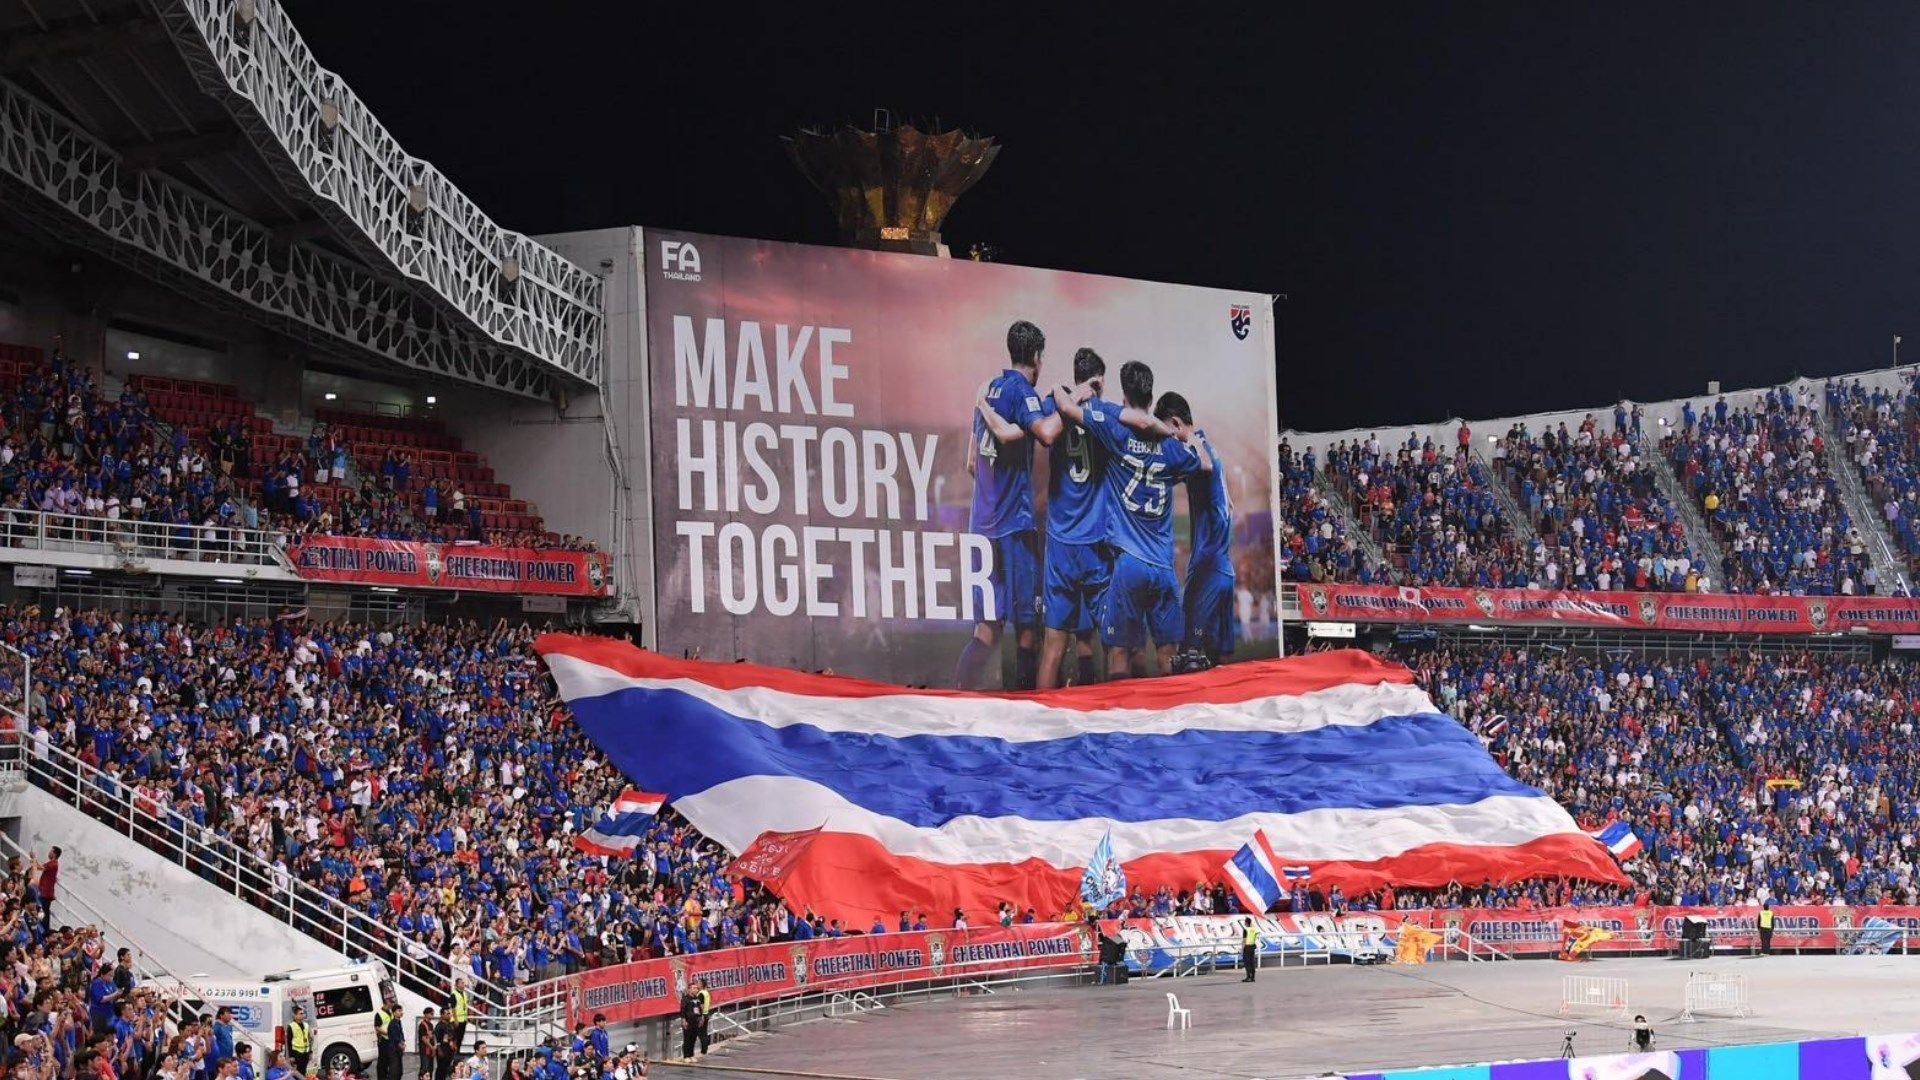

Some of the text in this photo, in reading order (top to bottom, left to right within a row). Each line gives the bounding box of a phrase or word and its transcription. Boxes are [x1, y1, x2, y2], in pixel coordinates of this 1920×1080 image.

[661, 241, 701, 272] FA
[663, 271, 702, 282] THAILAND
[673, 315, 854, 417] MAKE
[676, 418, 939, 521] HISTORY
[1121, 454, 1167, 516] 25
[365, 549, 418, 574] POWER
[446, 556, 577, 583] CHEERTHAI POWER
[675, 520, 997, 621] TOGETHER
[1419, 598, 1466, 610] OWER
[1664, 605, 1799, 623] CHEERTHAI POWER
[1837, 609, 1920, 621] CHEERTHAI
[1470, 920, 1560, 941] CHEERTHAI
[1773, 916, 1820, 936] OWER
[952, 937, 1074, 963] CHEERTHAI POWER
[747, 963, 786, 984] POWER
[813, 949, 922, 977] CHEERTHAI POWER
[238, 988, 259, 997] 9191
[583, 977, 668, 1010] CHEERTHAI POWER
